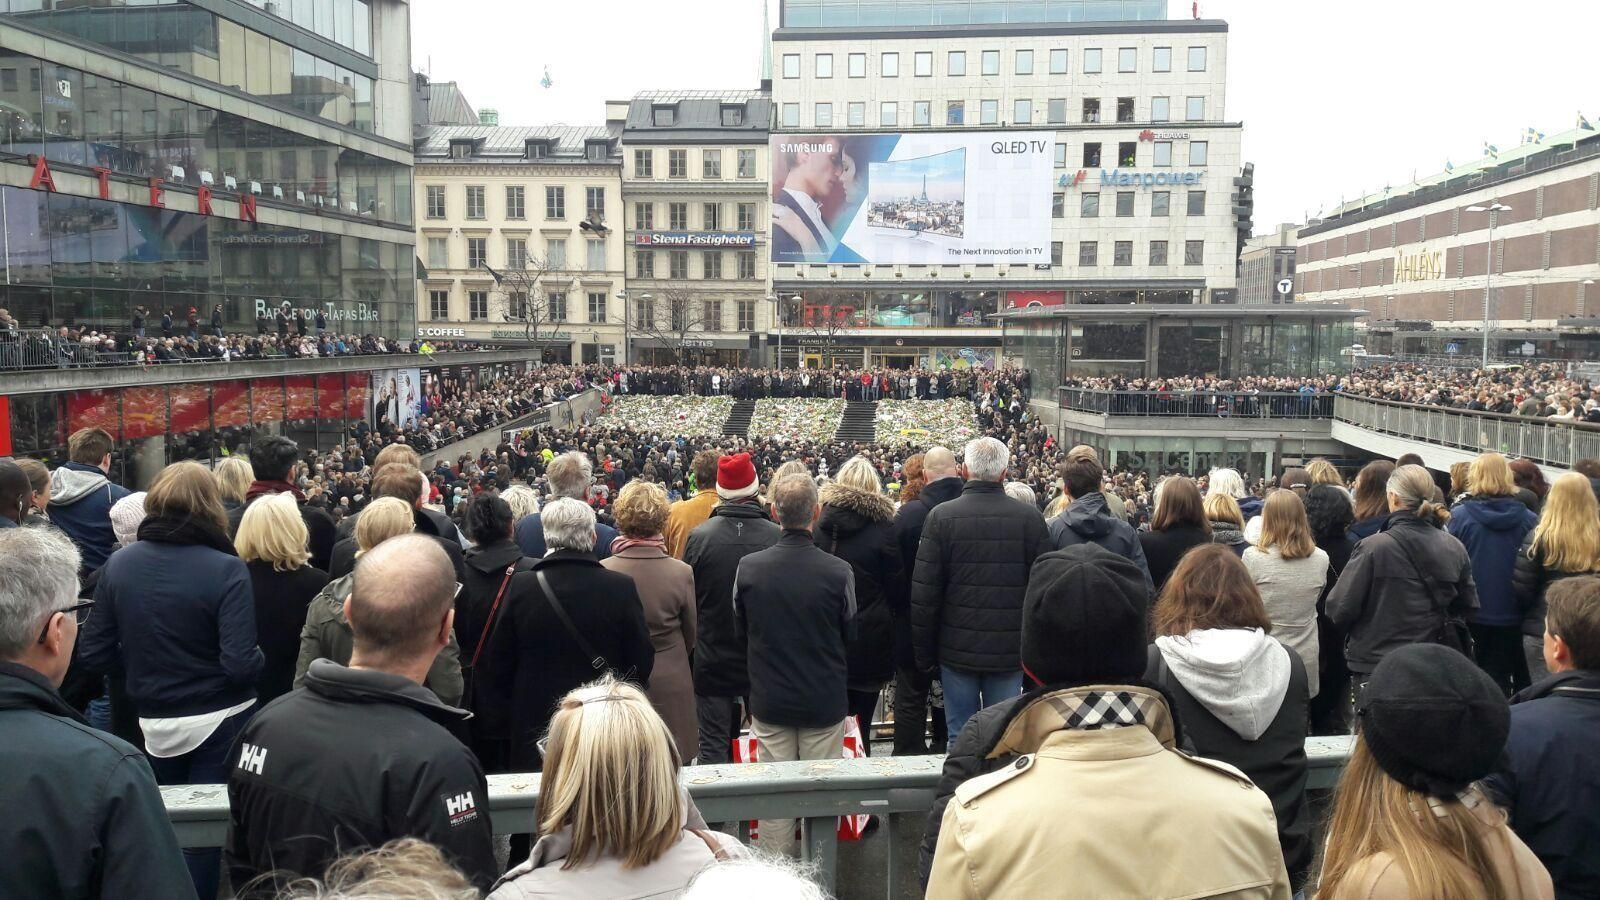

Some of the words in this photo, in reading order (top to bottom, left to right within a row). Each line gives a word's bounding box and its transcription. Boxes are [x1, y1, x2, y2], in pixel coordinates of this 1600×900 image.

[780, 143, 833, 153] SAMSUNG
[991, 141, 1027, 154] QLED
[1030, 140, 1046, 153] TV
[1101, 168, 1203, 190] Manpower
[652, 234, 686, 244] Stena
[687, 234, 753, 246] Fastigheter
[1395, 248, 1442, 283] ÅHLÉNS
[427, 328, 465, 337] COFFEE
[238, 743, 267, 775] HH
[446, 791, 475, 816] HH
